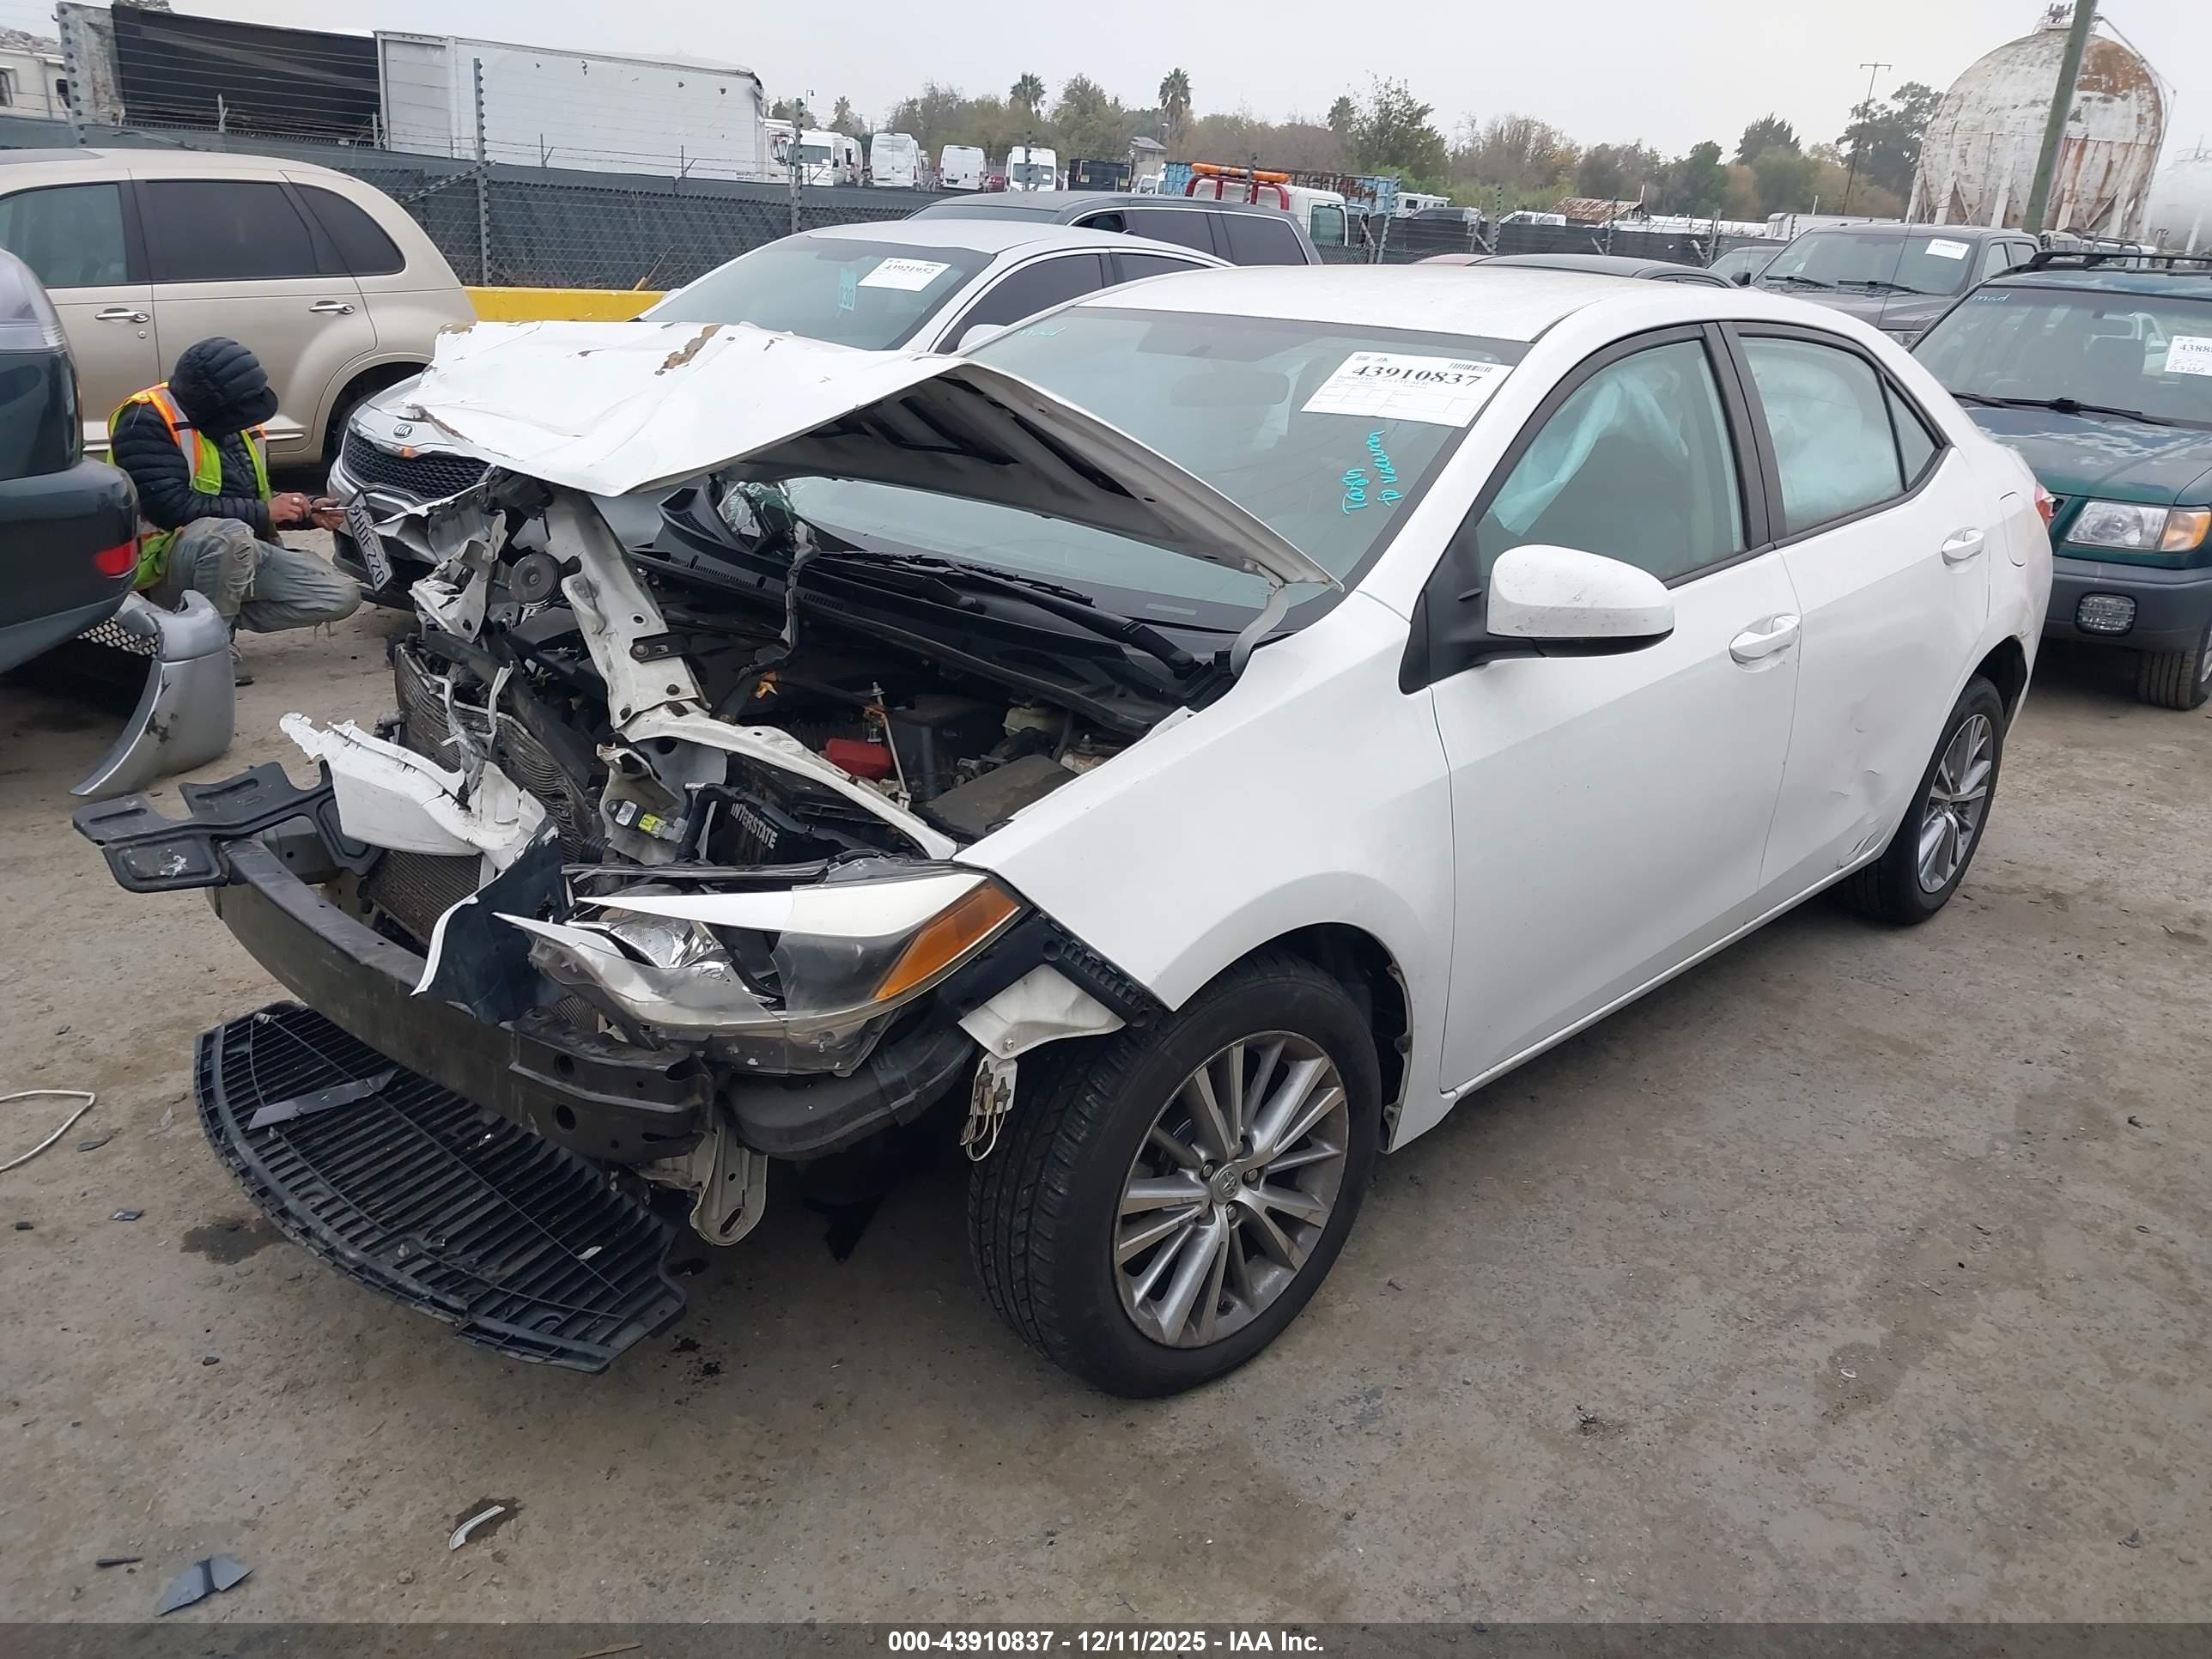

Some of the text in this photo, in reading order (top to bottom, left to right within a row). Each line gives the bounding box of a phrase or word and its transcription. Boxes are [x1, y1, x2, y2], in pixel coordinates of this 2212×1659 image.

[2179, 343, 2212, 355] 4388
[1352, 365, 1482, 386] 43910837
[396, 425, 411, 435] KIA
[349, 504, 386, 585] 9HDF220
[730, 803, 778, 849] INTERSTATE
